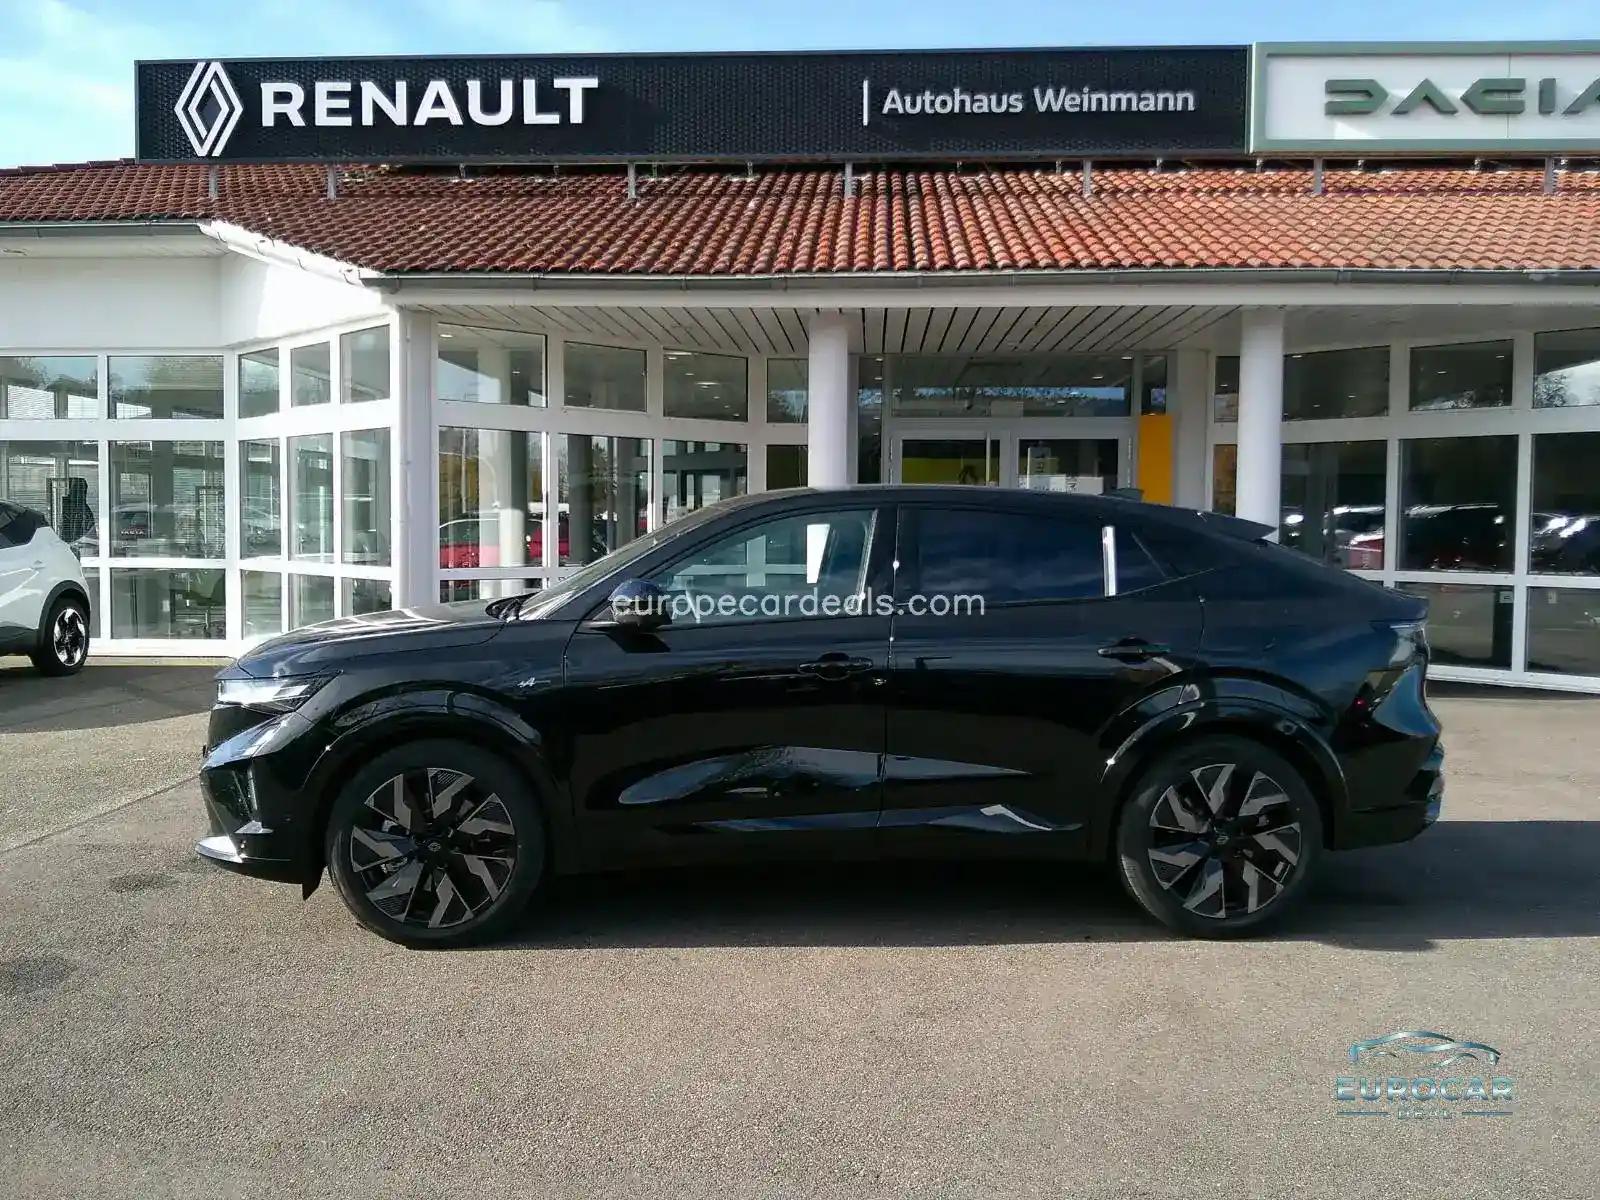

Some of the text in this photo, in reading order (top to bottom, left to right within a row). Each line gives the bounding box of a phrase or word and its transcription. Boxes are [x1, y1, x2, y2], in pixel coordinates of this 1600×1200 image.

[260, 77, 599, 127] RENAULT
[882, 85, 1196, 115] Autohaus Weinmann
[1325, 76, 1600, 116] DACIA
